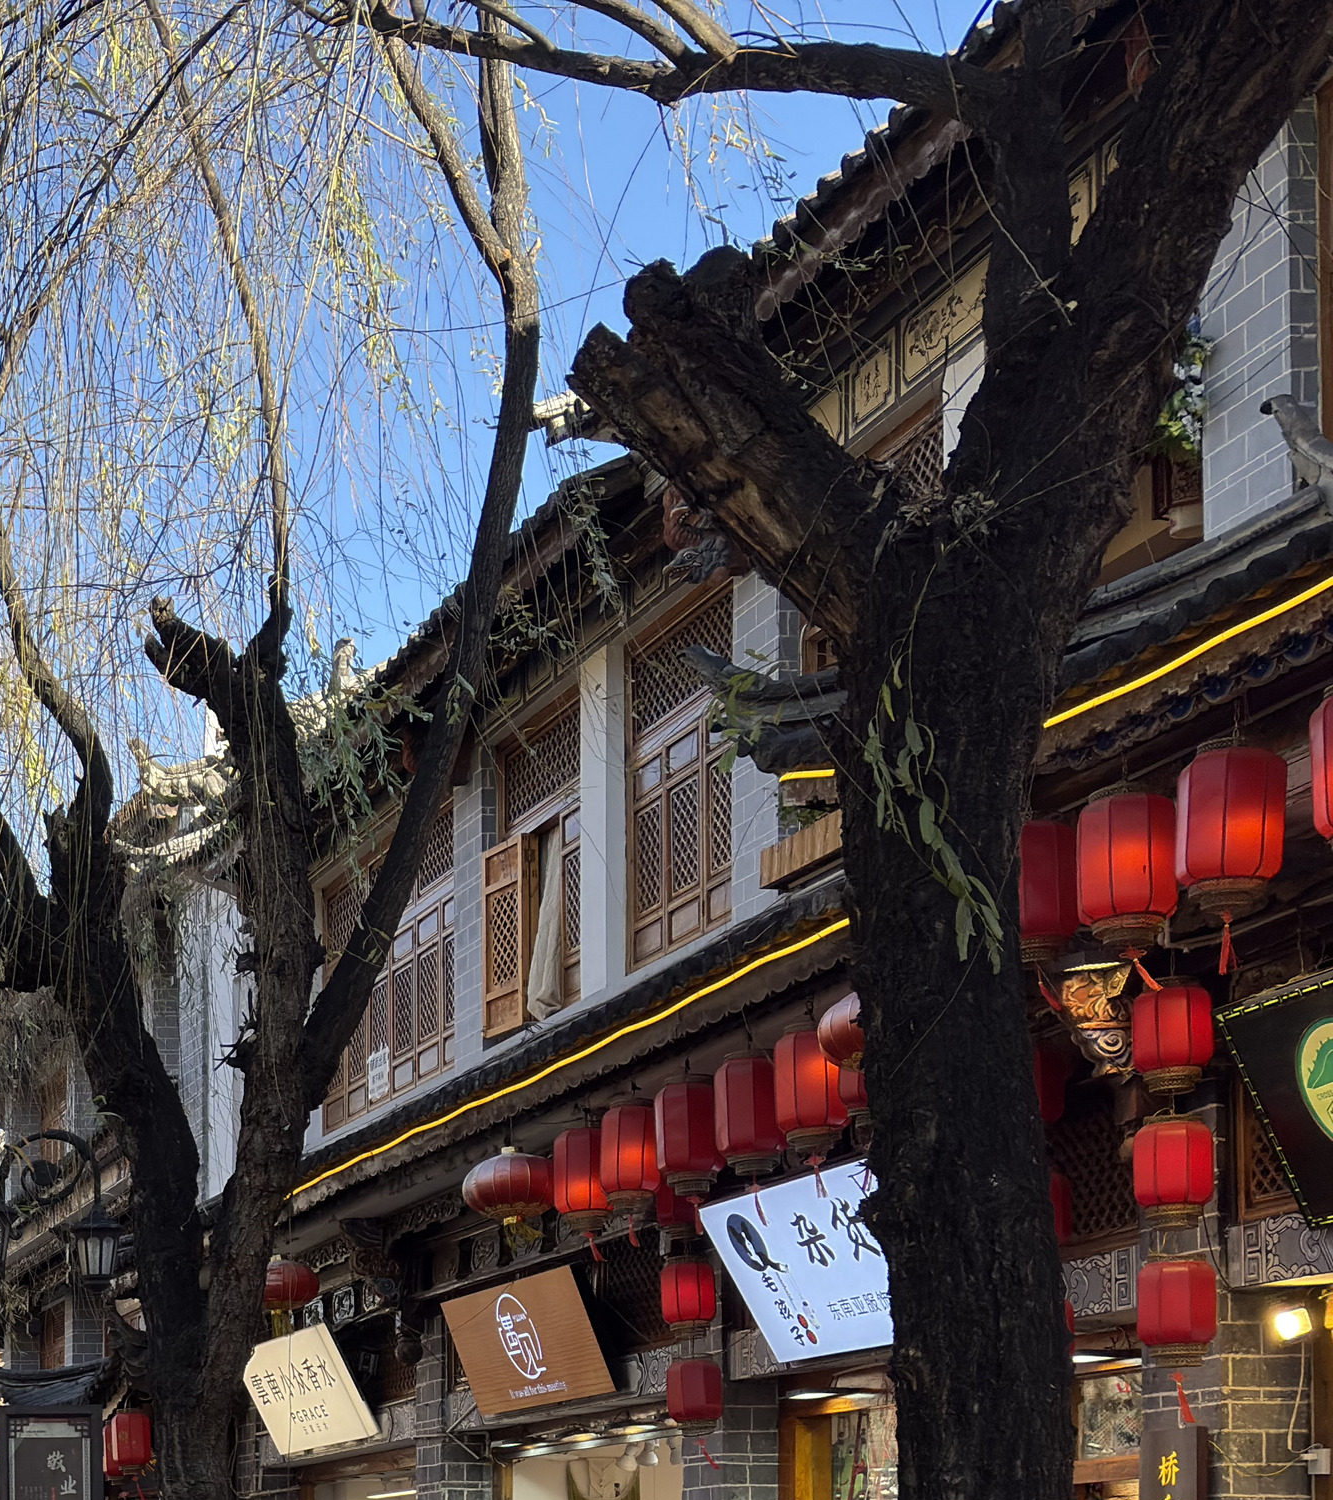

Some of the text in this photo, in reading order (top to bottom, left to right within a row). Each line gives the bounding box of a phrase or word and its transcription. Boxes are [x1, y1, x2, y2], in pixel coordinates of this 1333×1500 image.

[790, 1197, 882, 1268] 杂货
[826, 1290, 892, 1321] 东南亚服饰
[46, 1450, 77, 1496] 敬业
